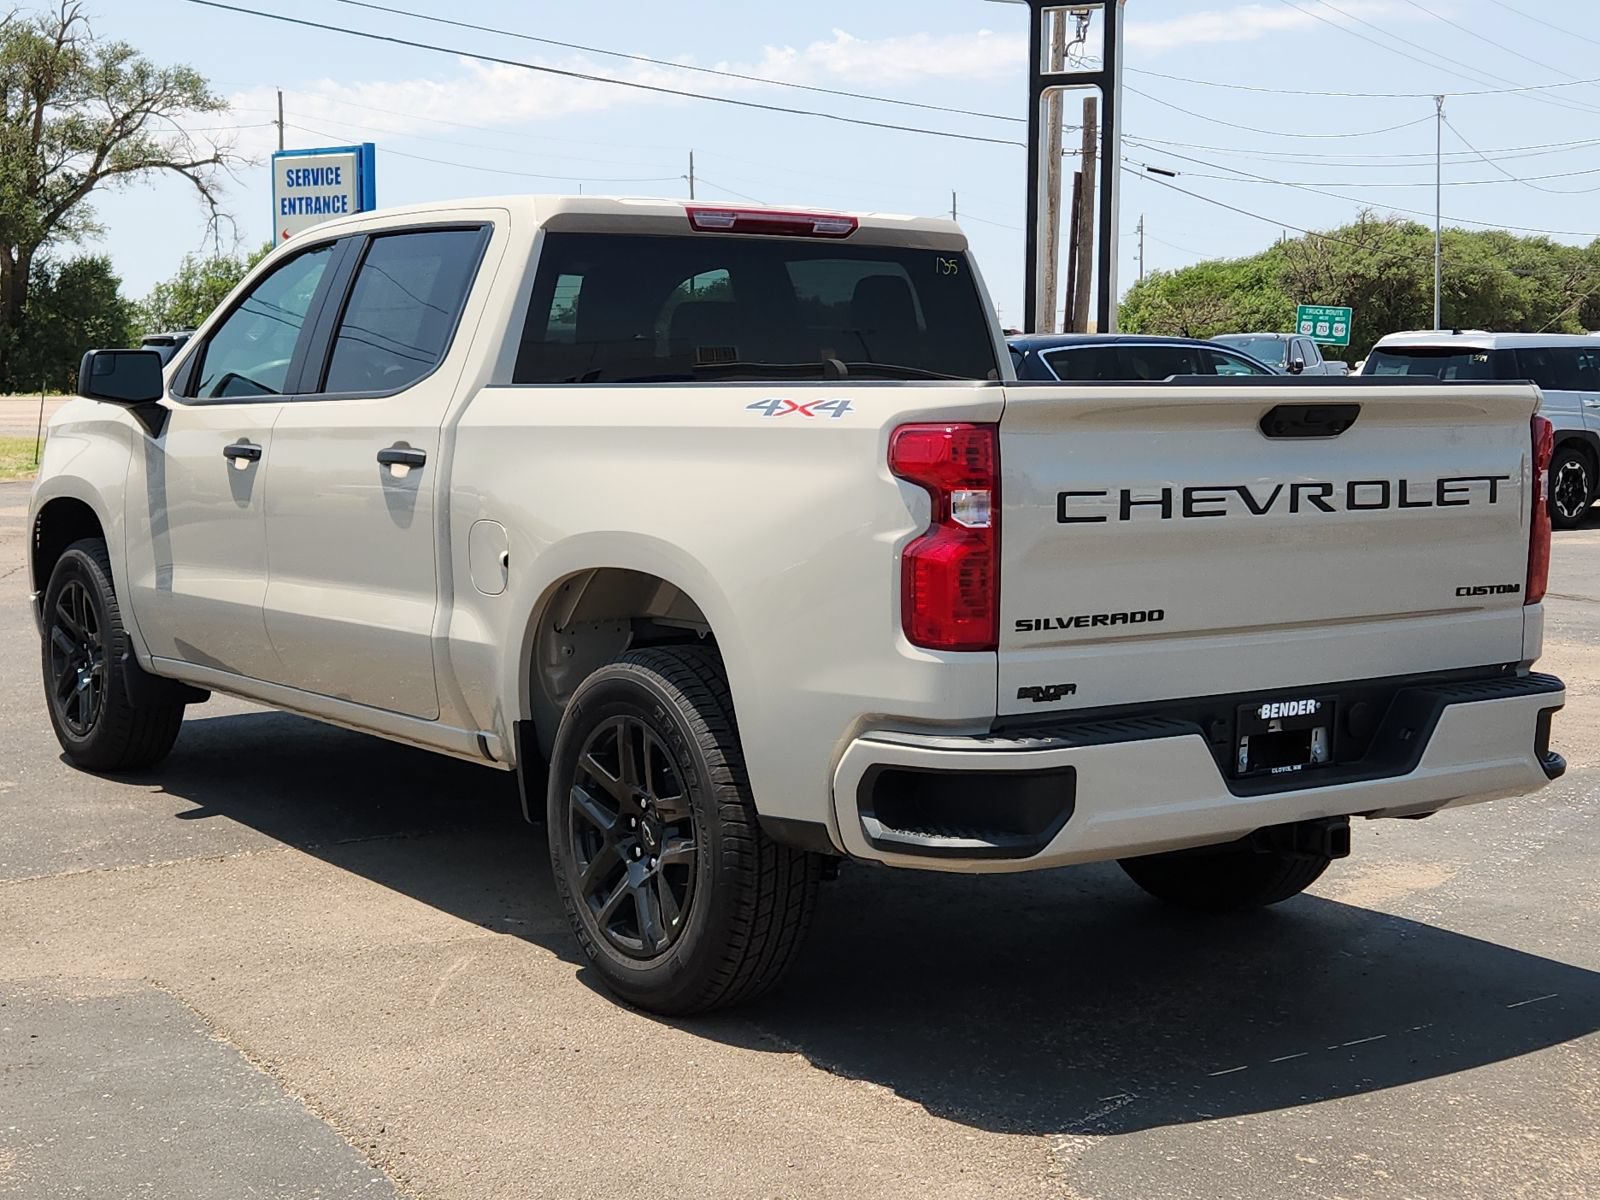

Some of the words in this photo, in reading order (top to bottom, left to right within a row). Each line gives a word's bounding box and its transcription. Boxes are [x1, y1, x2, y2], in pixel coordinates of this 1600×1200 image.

[286, 166, 341, 188] SERVICE
[280, 194, 348, 216] ENTRANCE
[1301, 324, 1311, 332] 60
[1056, 475, 1510, 524] CHEVROLET
[1455, 583, 1520, 597] CUSTOM
[1015, 609, 1164, 632] SILVERADO
[1261, 699, 1316, 719] BENDER
